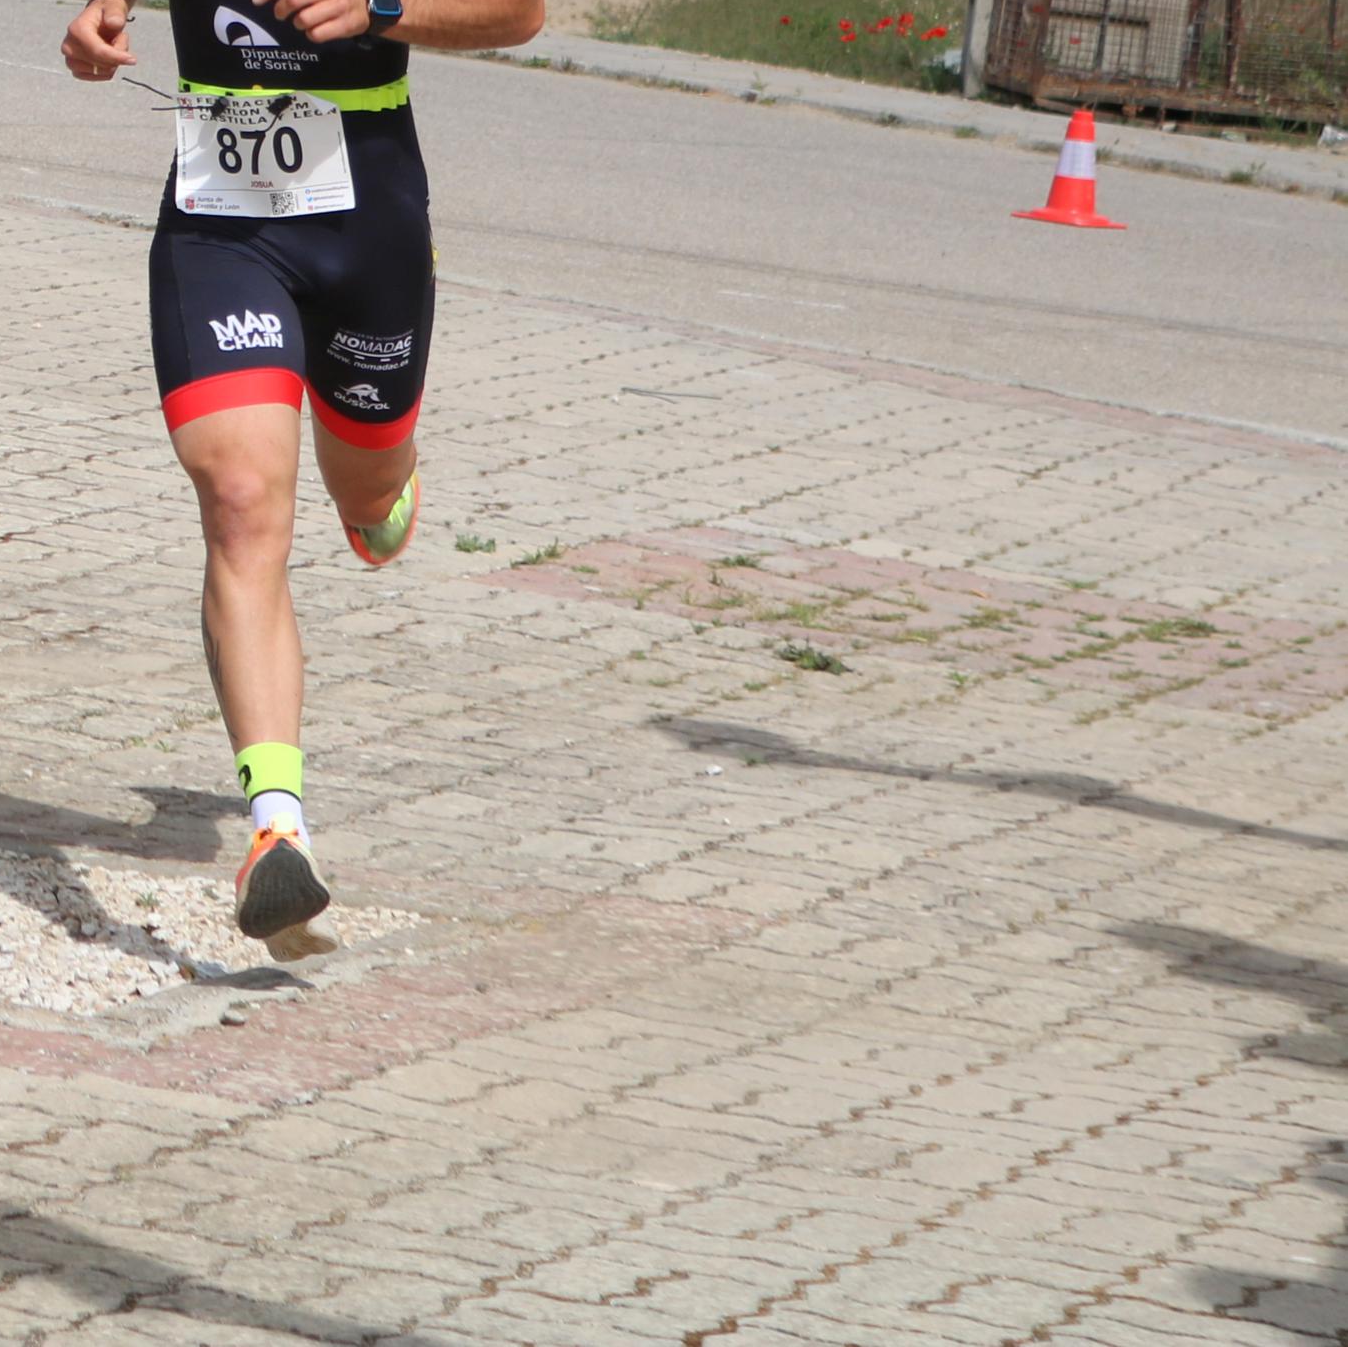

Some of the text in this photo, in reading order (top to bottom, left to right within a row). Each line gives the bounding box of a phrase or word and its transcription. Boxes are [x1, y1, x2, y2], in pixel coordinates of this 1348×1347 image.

[241, 48, 319, 63] Diputación
[244, 60, 302, 71] de Soria
[216, 126, 303, 176] 870
[208, 308, 282, 341] MAD
[334, 332, 413, 353] NOMADAC
[333, 391, 391, 410] austral
